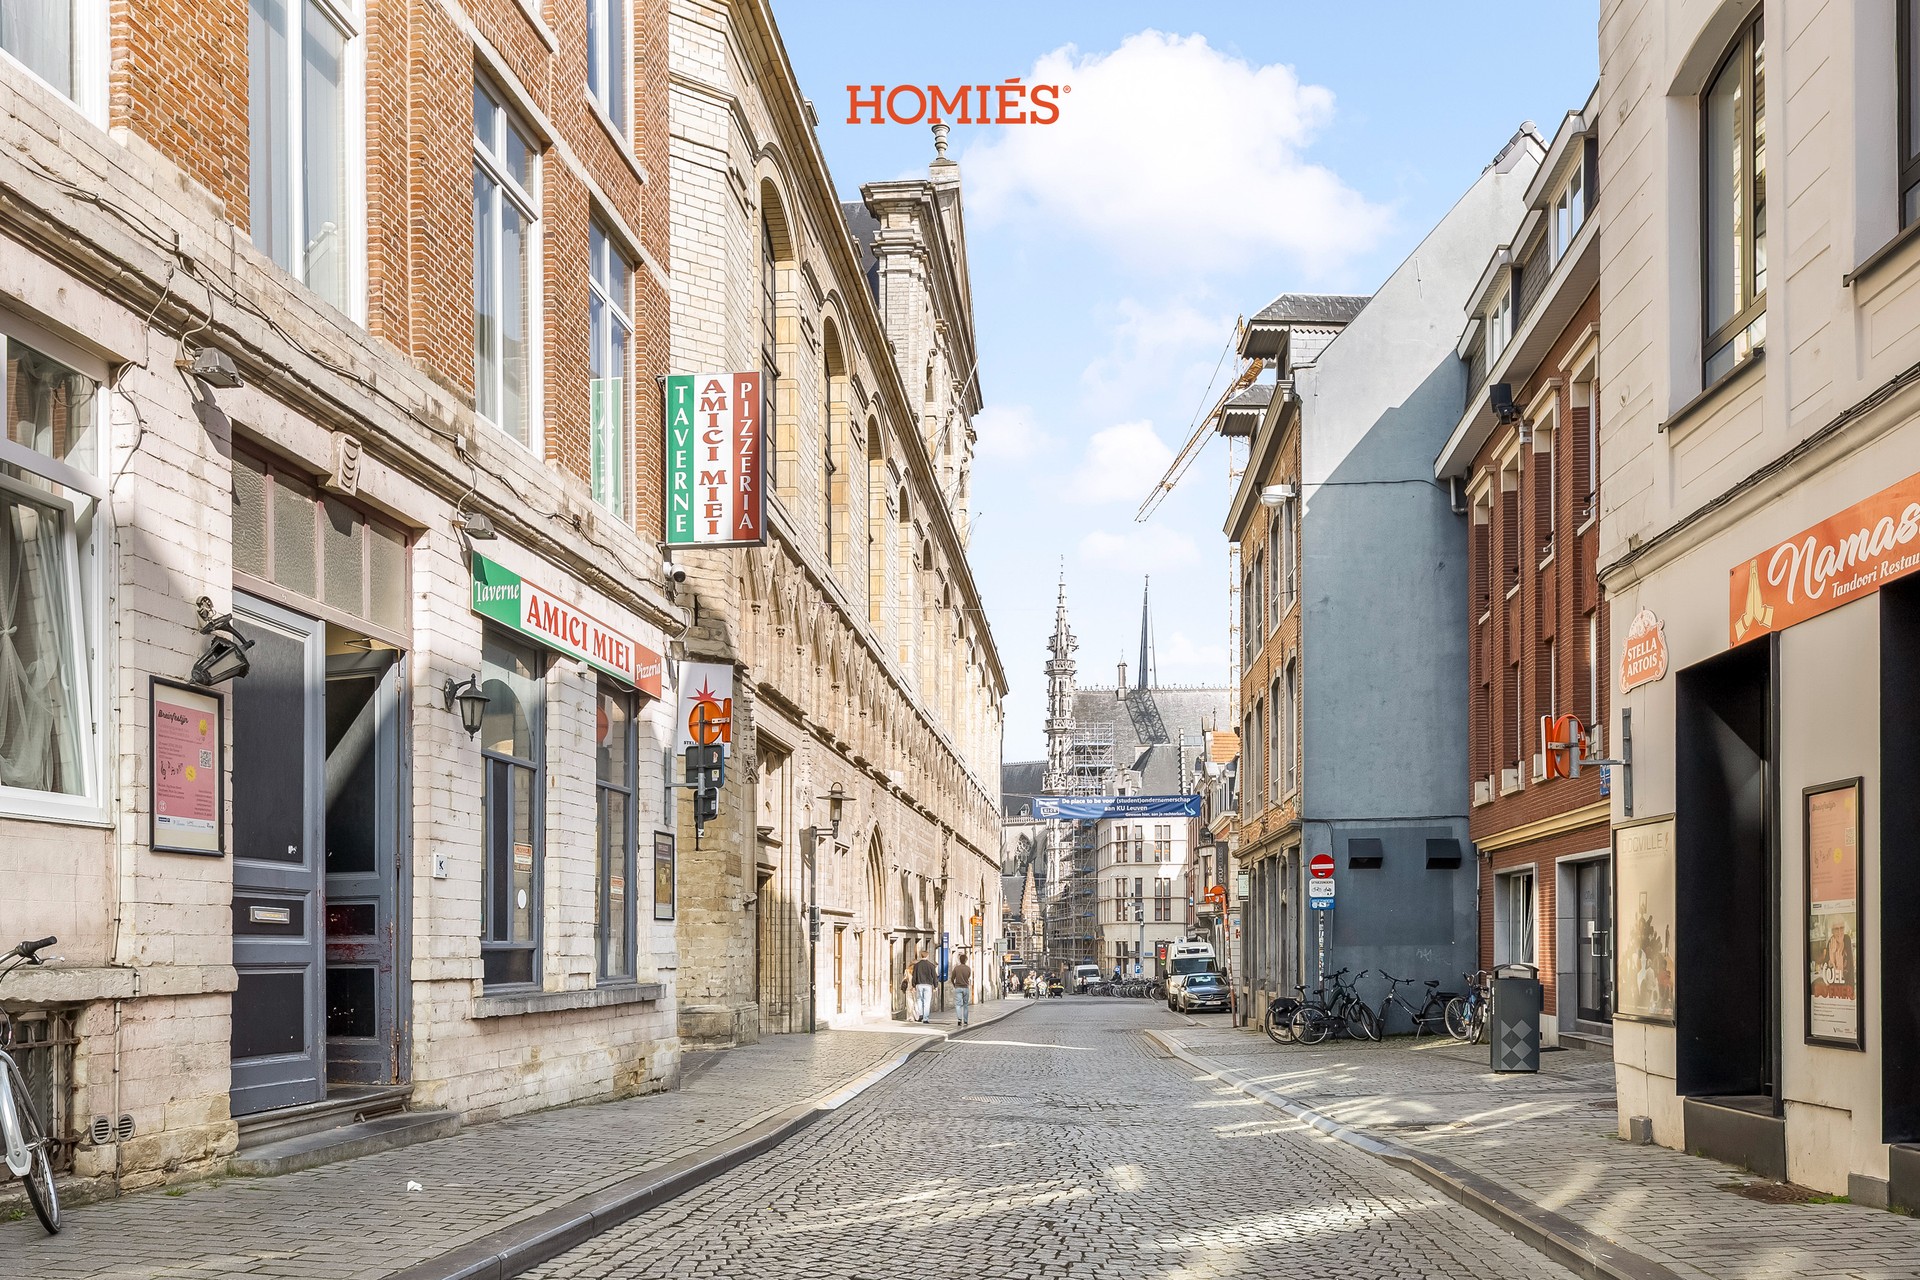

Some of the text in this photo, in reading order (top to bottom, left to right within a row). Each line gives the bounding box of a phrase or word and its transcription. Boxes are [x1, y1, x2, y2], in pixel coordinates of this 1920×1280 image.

[673, 385, 689, 533] TAVERNE
[699, 379, 728, 535] AMICI MIEI
[738, 382, 753, 530] PIZZERIA
[1767, 502, 1920, 604] Namas
[474, 581, 520, 605] Taverne
[1831, 565, 1877, 599] Tandoori
[526, 594, 631, 673] AMICI MIEI
[1627, 637, 1658, 662] STELLA
[636, 659, 661, 681] Pizzeria
[1626, 653, 1659, 678] ARTOIS
